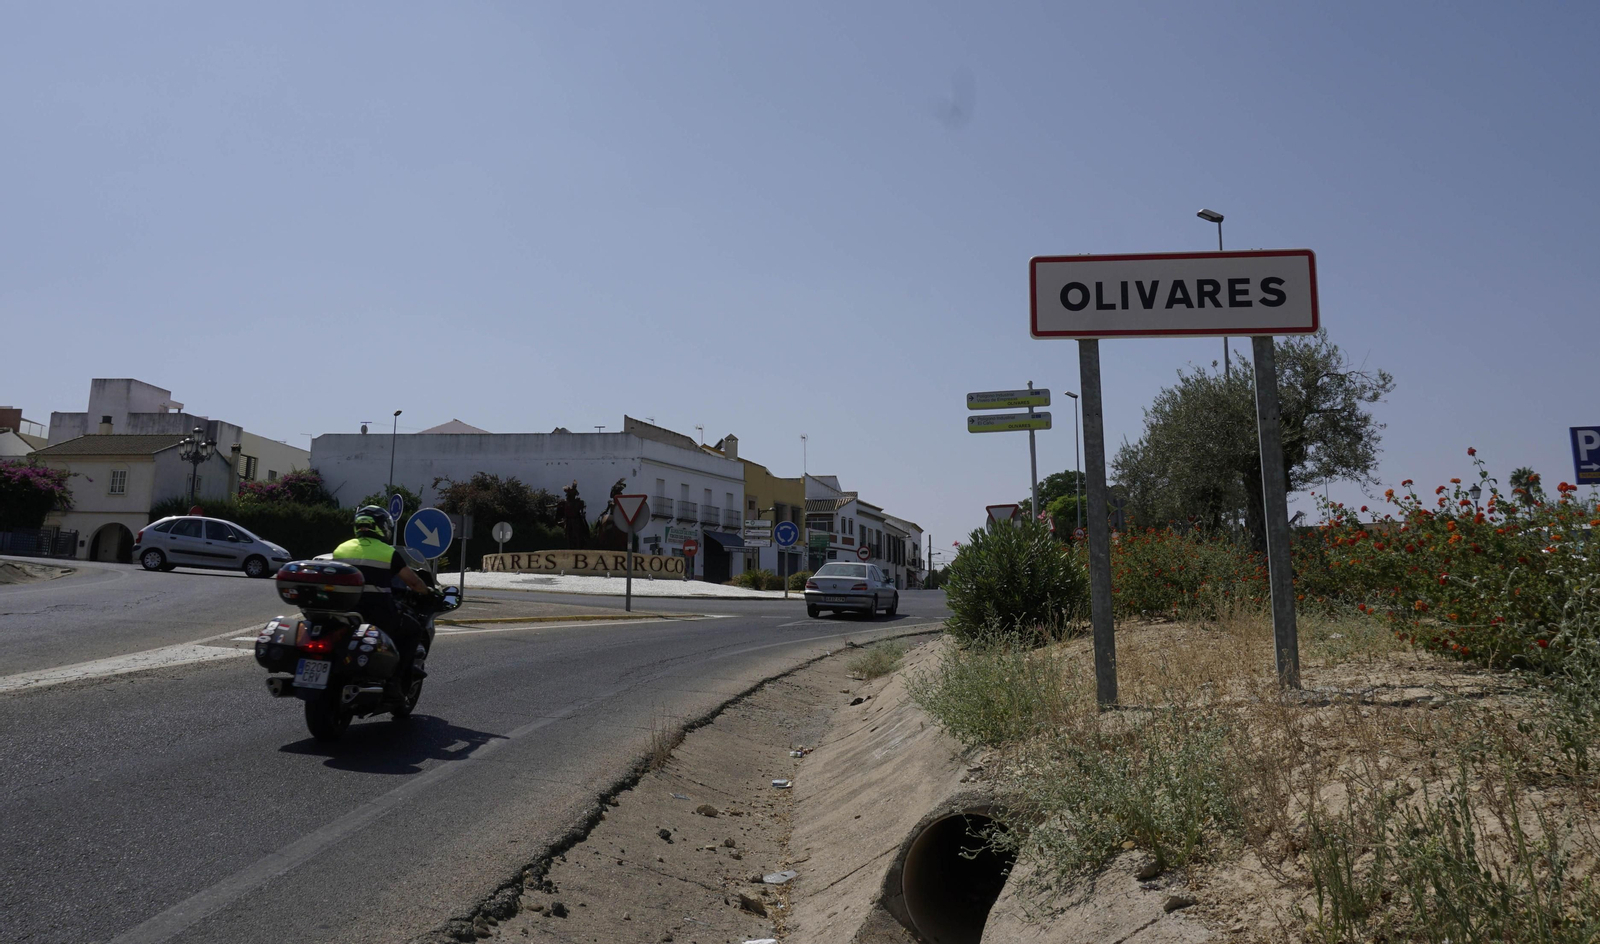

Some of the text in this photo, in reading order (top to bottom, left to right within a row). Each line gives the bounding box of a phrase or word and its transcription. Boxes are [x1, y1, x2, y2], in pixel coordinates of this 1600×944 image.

[1059, 276, 1287, 312] OLIVARES
[1577, 430, 1600, 461] P
[573, 553, 684, 574] BARROCO
[302, 671, 320, 682] CRV
[305, 661, 328, 673] 6208
